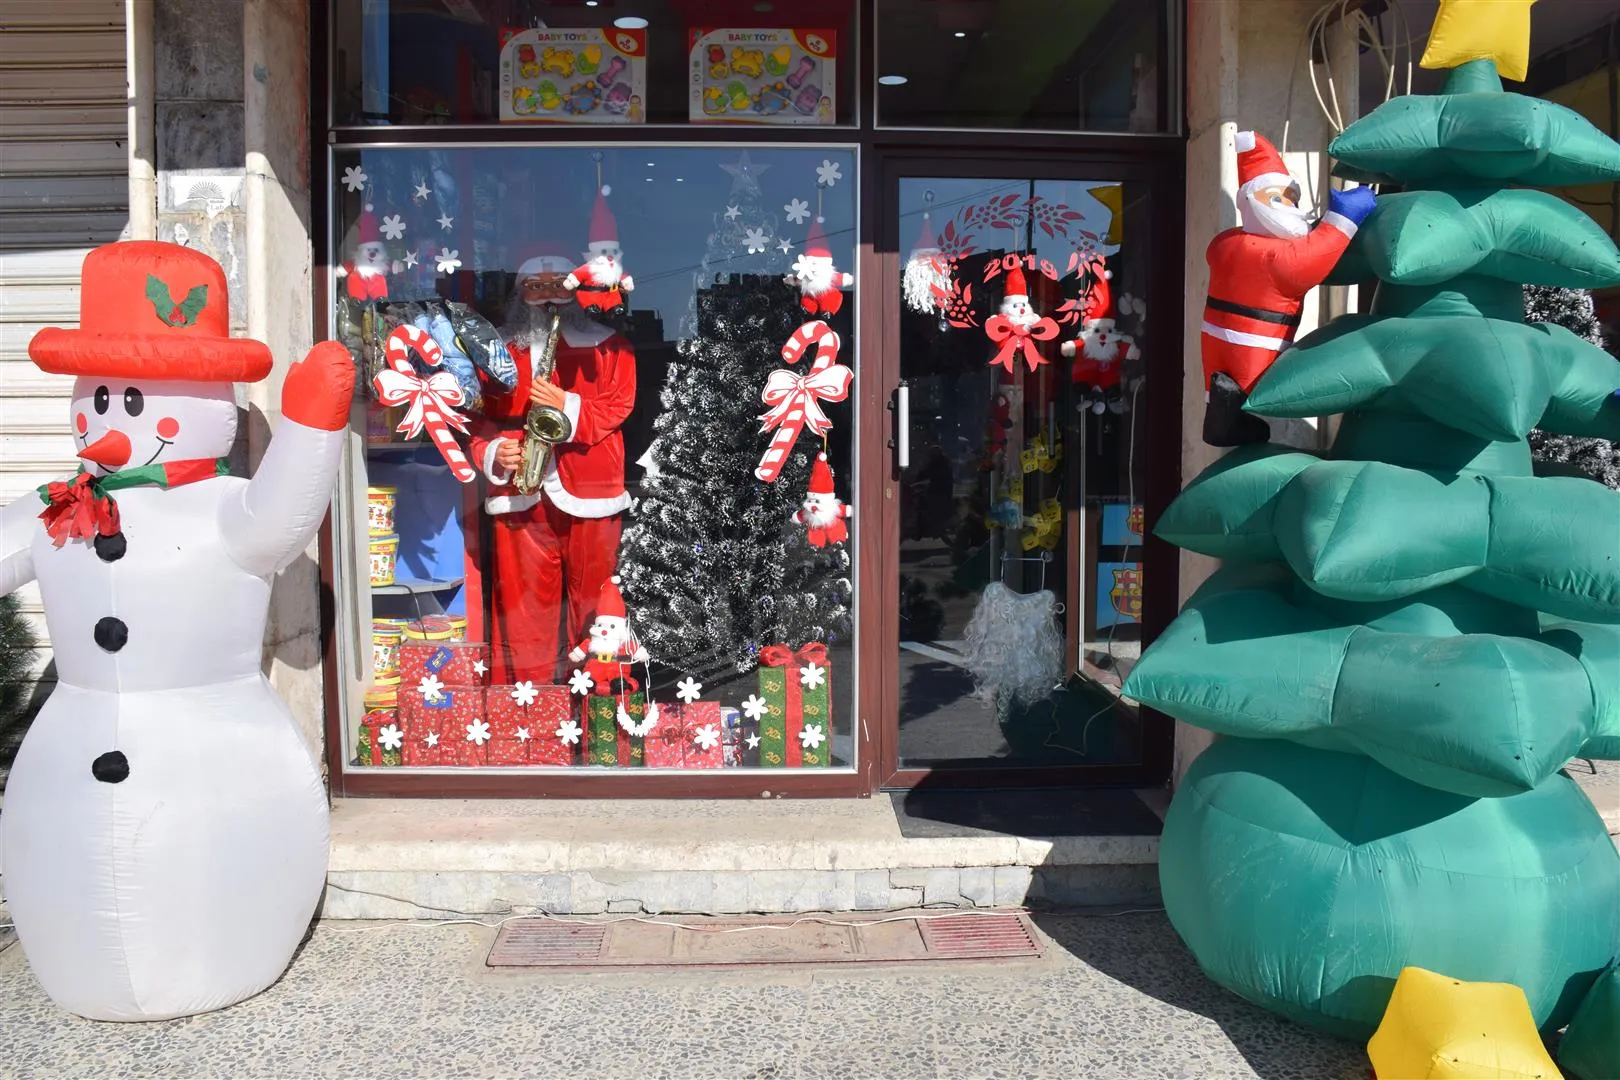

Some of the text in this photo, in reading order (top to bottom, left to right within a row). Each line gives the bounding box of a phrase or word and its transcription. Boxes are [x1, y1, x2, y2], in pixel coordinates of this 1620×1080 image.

[538, 33, 588, 41] BABY TOYS
[728, 33, 778, 41] BABY TOYS
